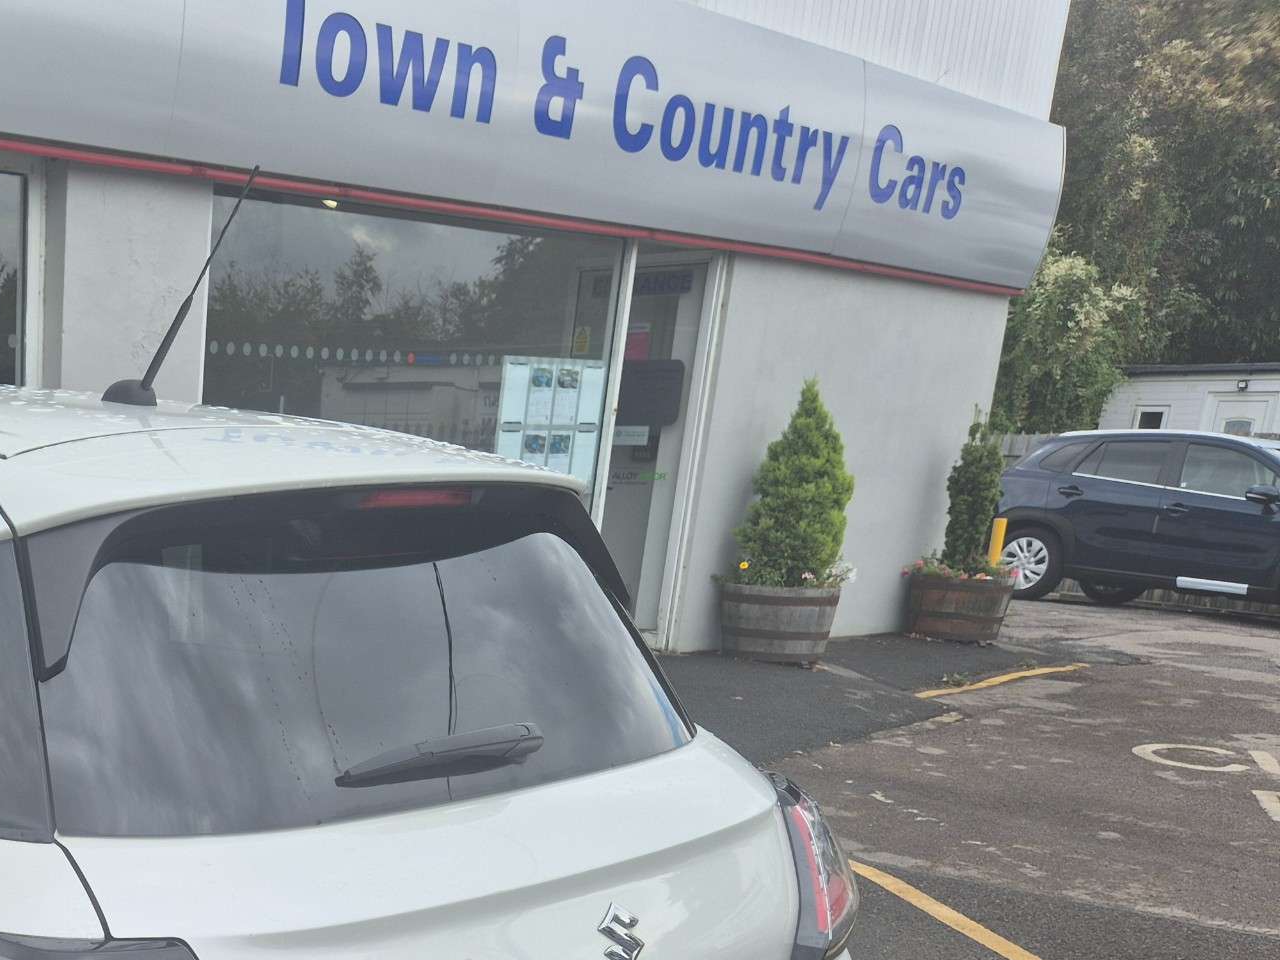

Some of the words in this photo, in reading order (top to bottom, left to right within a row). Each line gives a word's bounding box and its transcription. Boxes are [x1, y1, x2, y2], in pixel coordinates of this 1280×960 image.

[534, 35, 584, 140] &
[613, 55, 850, 210] Country
[869, 124, 967, 221] Cars
